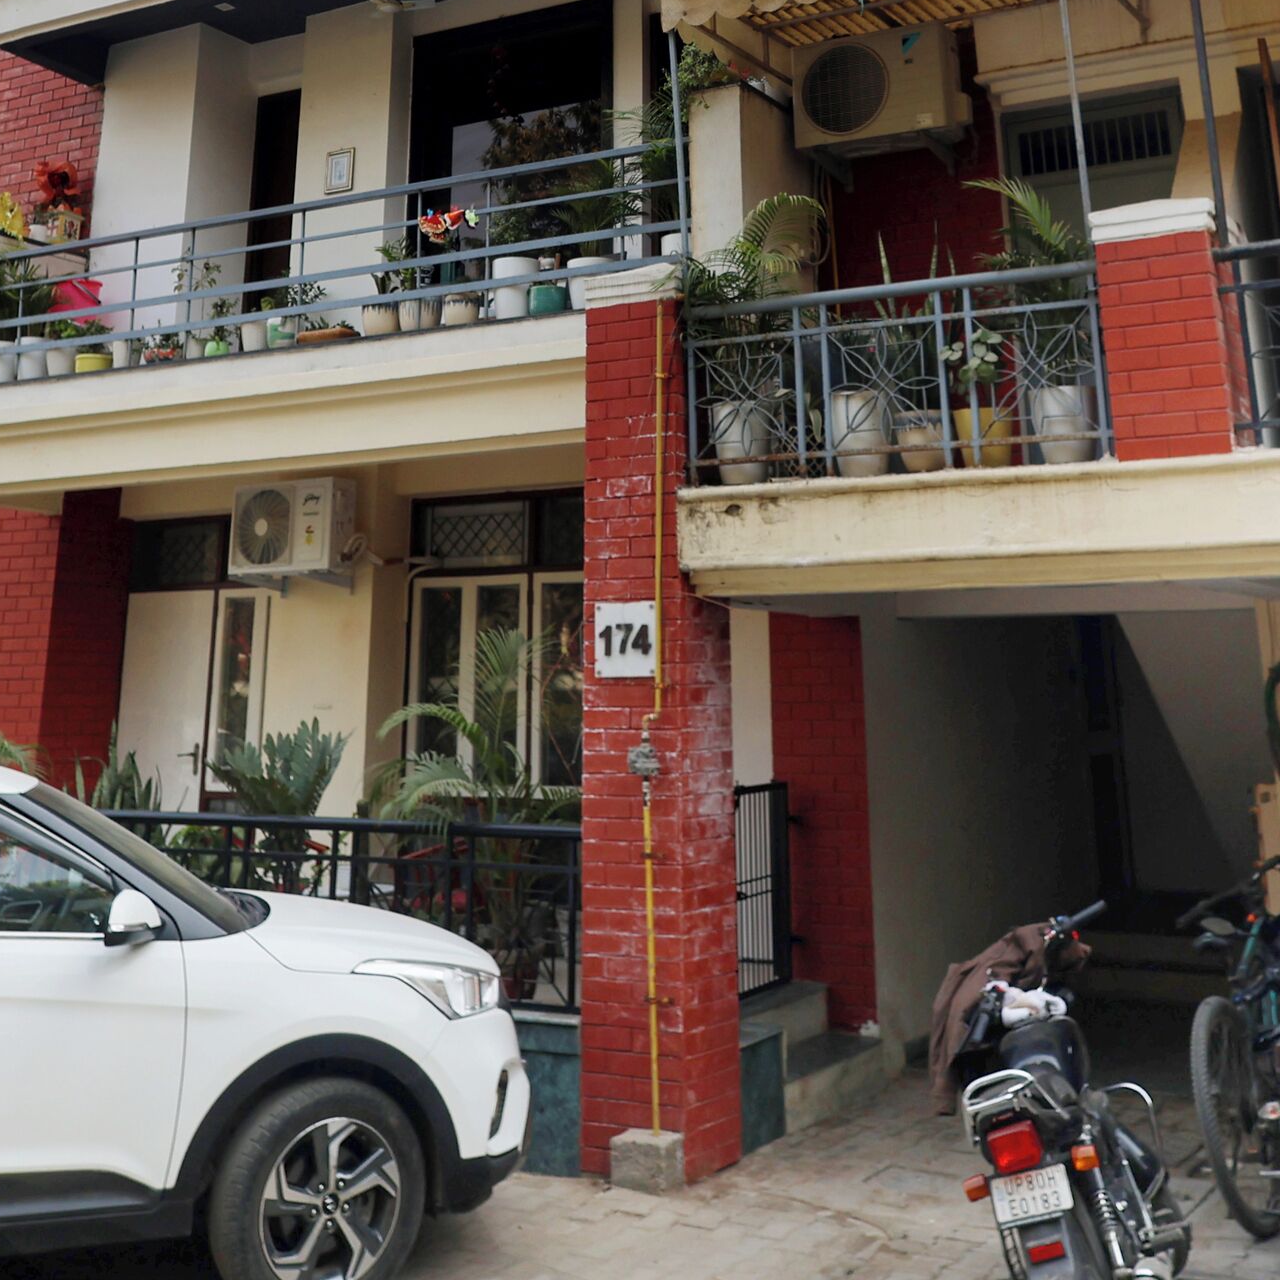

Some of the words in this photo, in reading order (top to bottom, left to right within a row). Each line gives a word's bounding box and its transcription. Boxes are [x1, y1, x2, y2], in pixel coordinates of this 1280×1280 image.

[598, 623, 652, 657] 174
[1004, 1167, 1056, 1195] UP80H
[1008, 1190, 1062, 1217] E0183
